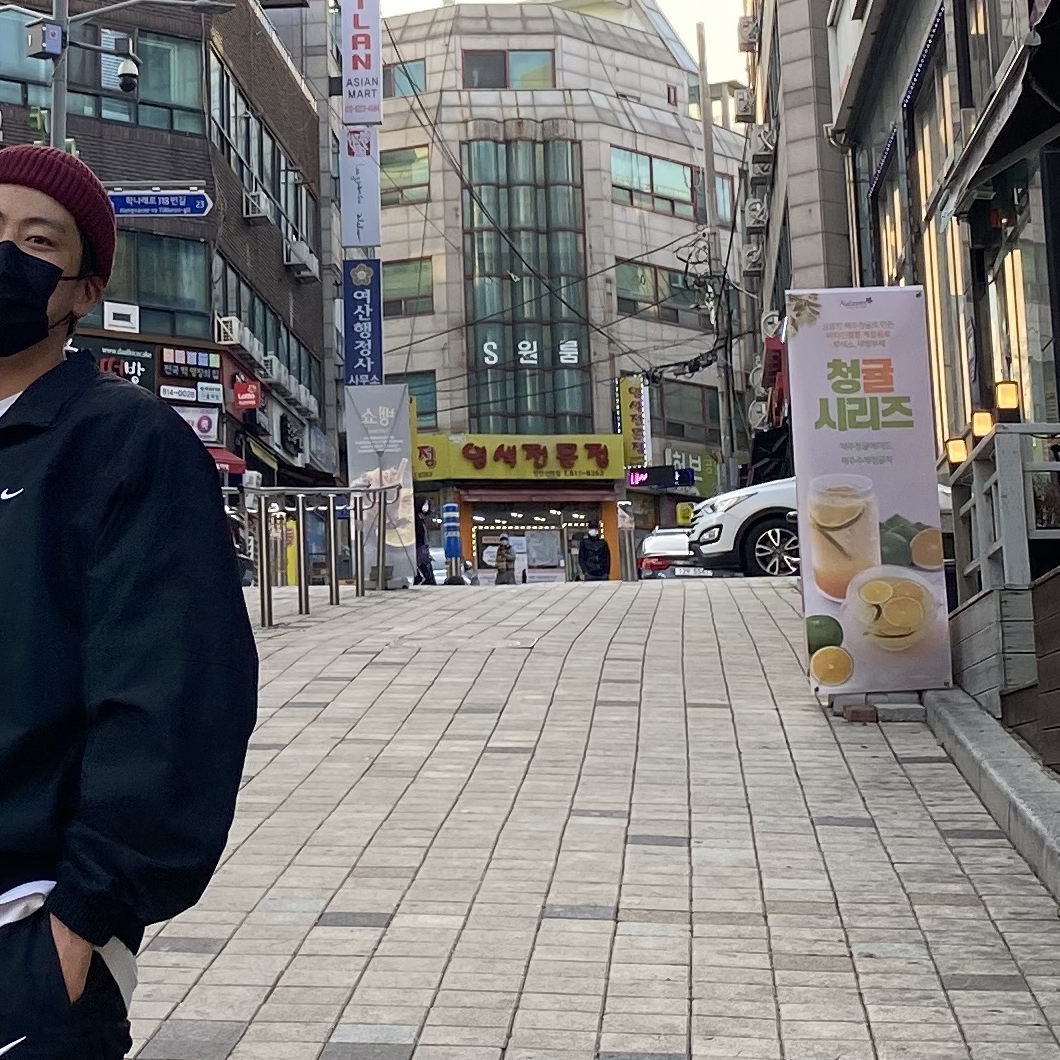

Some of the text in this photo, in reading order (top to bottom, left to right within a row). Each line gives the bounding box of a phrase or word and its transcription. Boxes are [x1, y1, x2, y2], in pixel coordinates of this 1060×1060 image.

[346, 78, 378, 87] ASIAN
[348, 89, 377, 98] MART
[353, 289, 374, 372] 여산행정사
[348, 374, 380, 386] 사무소
[827, 358, 894, 394] 청귤
[814, 396, 914, 431] 시리즈
